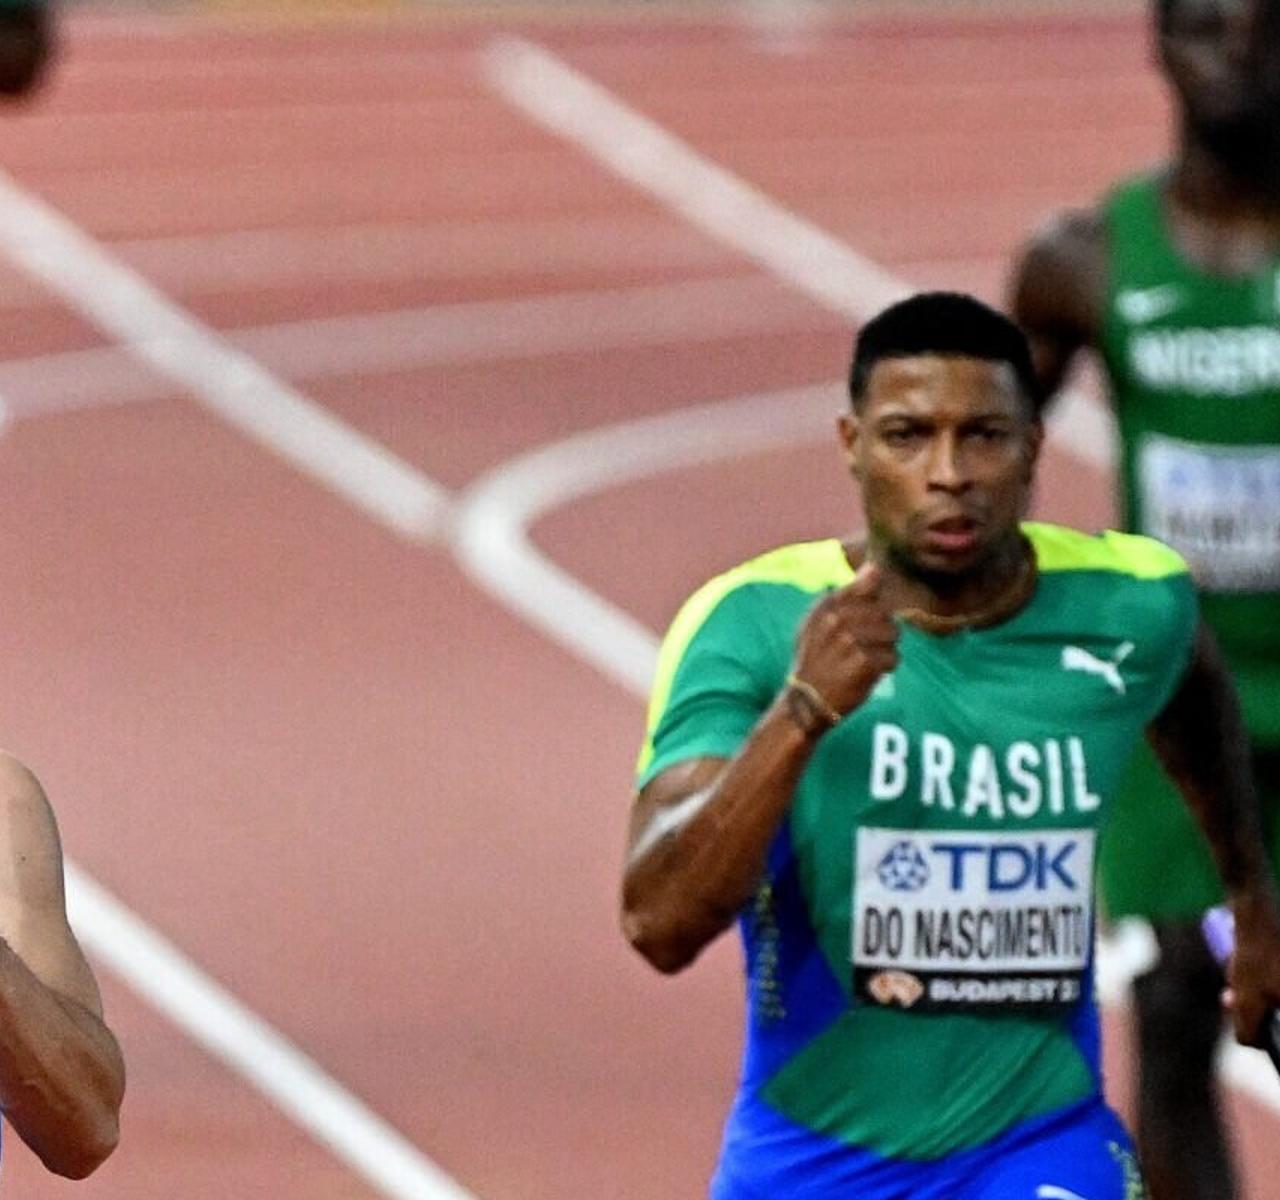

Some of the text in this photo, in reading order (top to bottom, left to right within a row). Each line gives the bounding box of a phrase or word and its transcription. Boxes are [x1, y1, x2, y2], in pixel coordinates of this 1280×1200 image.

[871, 722, 1101, 820] BRASIL
[930, 841, 1078, 892] TDK
[863, 906, 903, 956] DO
